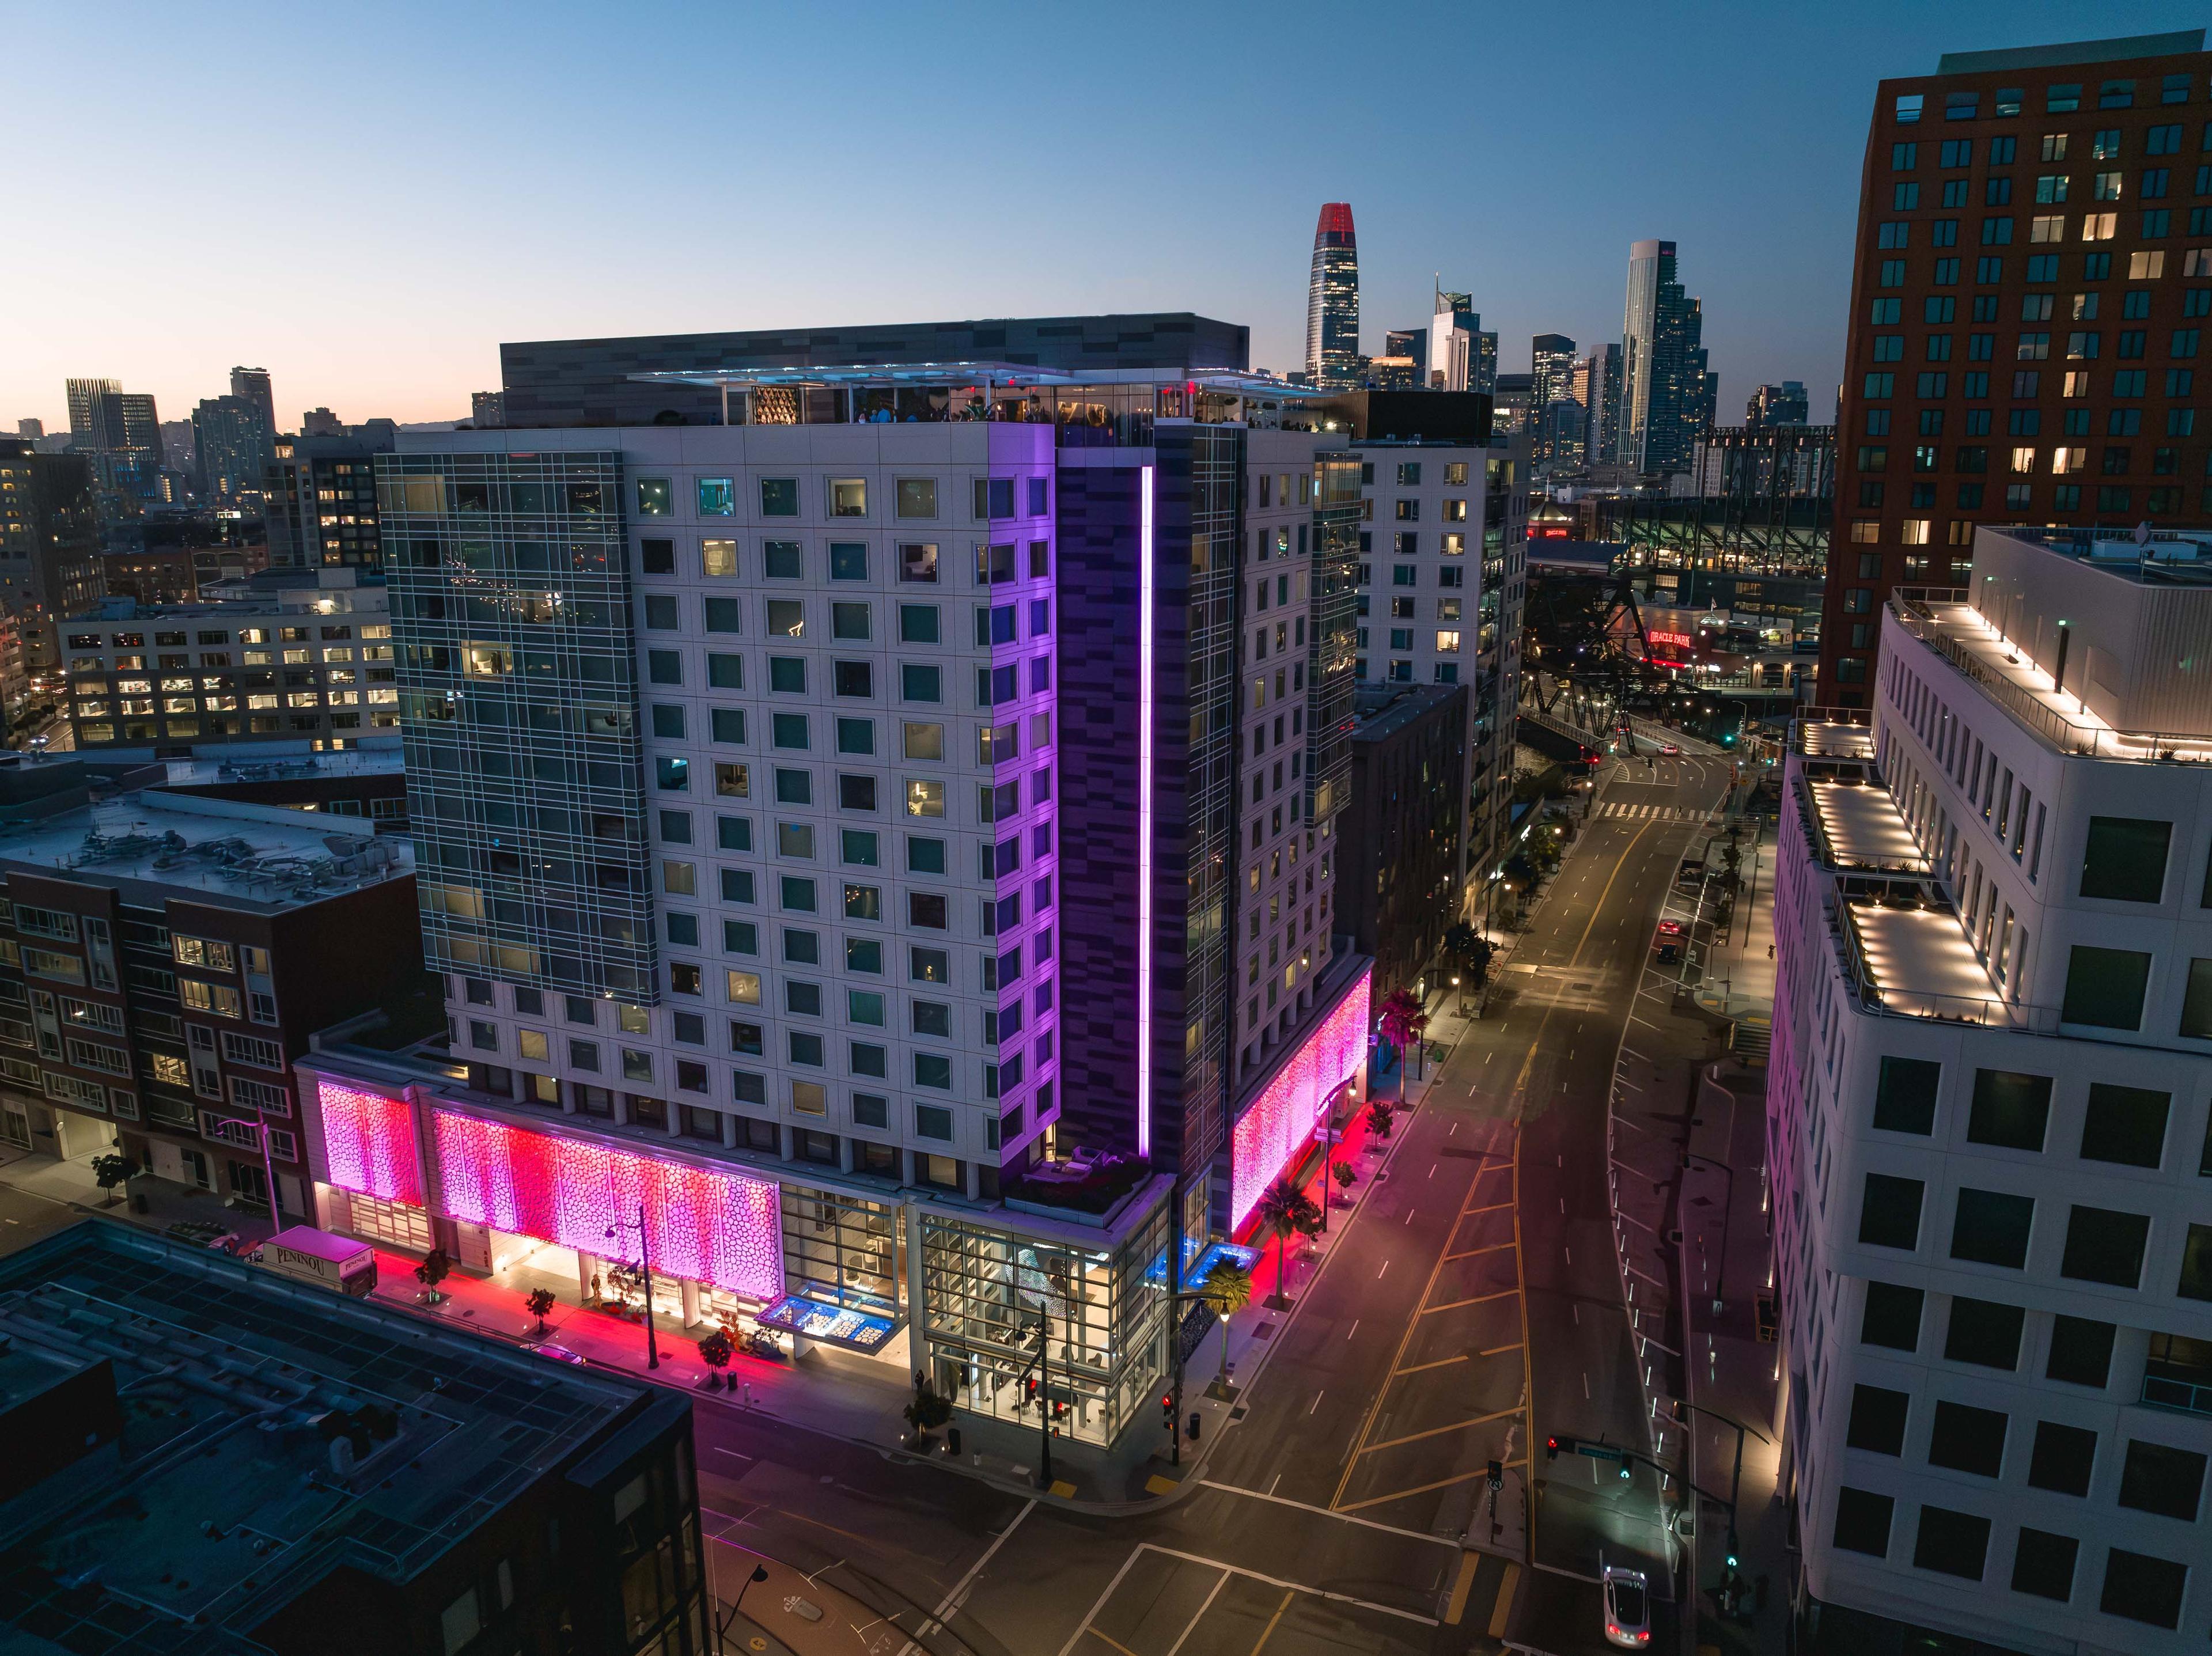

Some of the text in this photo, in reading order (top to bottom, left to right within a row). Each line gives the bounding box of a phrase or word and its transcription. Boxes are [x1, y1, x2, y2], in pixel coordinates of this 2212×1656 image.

[1650, 631, 1690, 647] ORACLE PARK
[276, 1248, 324, 1276] PENINOU
[346, 1255, 367, 1271] PENINOU
